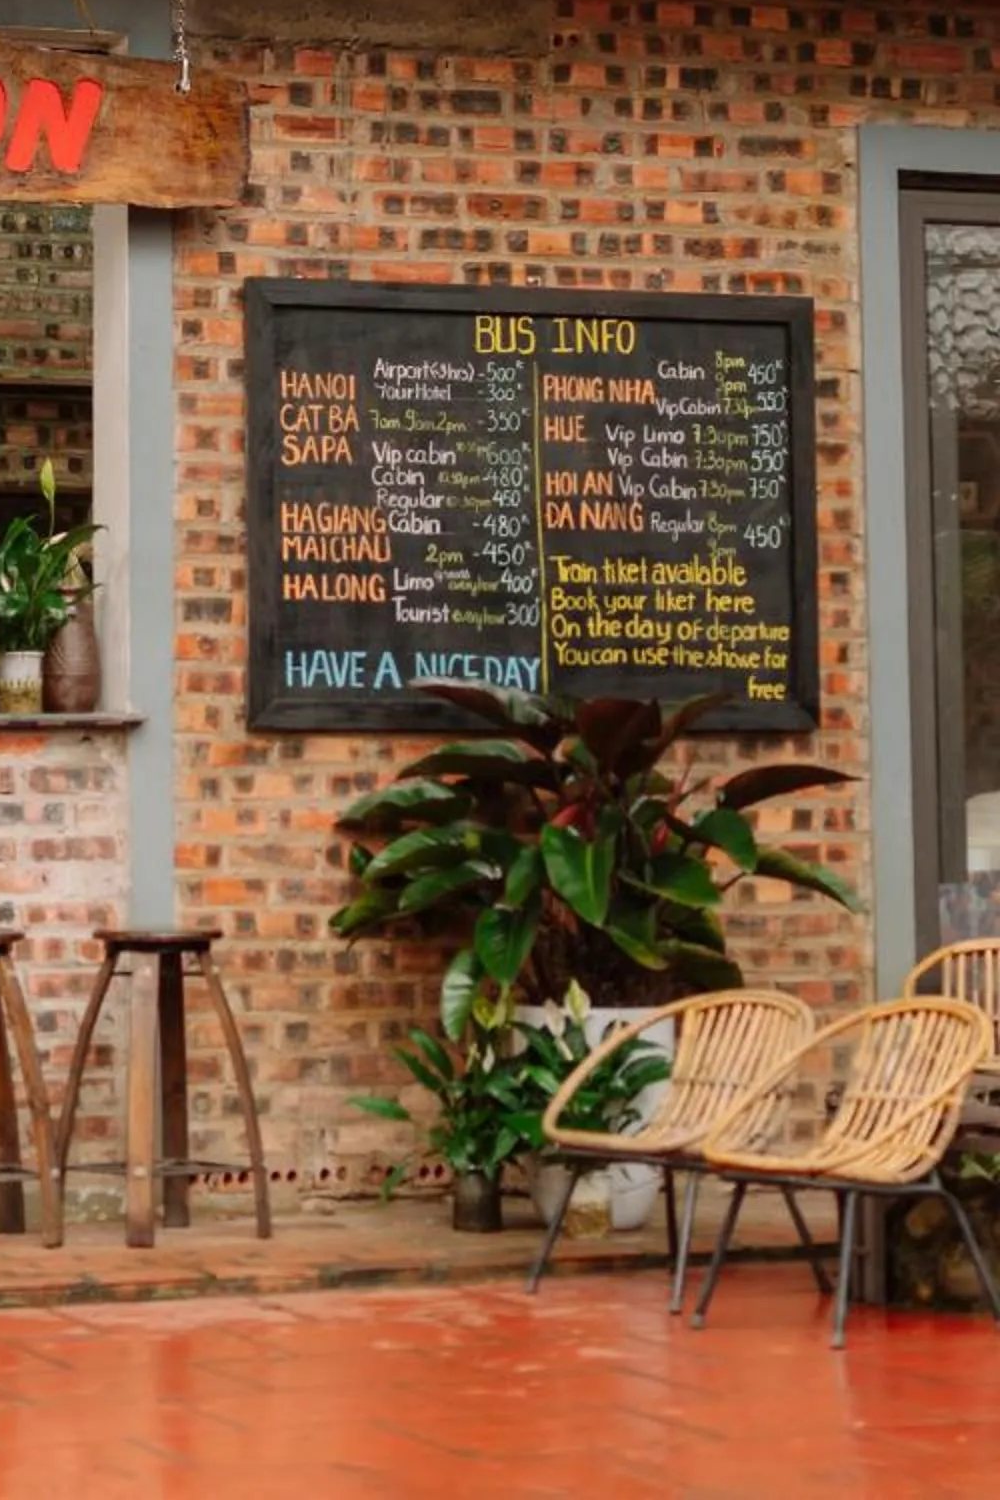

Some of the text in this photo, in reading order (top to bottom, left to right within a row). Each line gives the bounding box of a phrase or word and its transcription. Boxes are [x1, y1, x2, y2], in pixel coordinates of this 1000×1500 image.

[474, 315, 636, 355] BUS INFO
[280, 369, 355, 399] HANOI
[657, 360, 705, 380] Cabin
[543, 374, 657, 406] PHONG NHA
[280, 403, 324, 432] CAT
[328, 404, 360, 433] BA
[544, 415, 587, 443] HUE
[605, 423, 636, 447] Vip
[643, 424, 685, 444] Limo
[281, 435, 353, 466] SAPA
[371, 441, 402, 470] Vip
[406, 440, 457, 466] cabin
[607, 448, 634, 474] Vip
[640, 449, 688, 470] Cabin
[371, 465, 424, 486] Cabin
[546, 471, 578, 497] HOI
[582, 470, 613, 496] AN
[617, 475, 645, 502] Vip
[650, 474, 697, 500] Cabin
[376, 487, 445, 516] Regular
[388, 509, 441, 535] Cabin
[581, 501, 645, 533] NANG
[650, 508, 704, 542] Regular
[424, 543, 464, 568] 2pm
[549, 555, 597, 583] Train
[652, 554, 747, 587] available
[393, 568, 434, 592] Limo
[392, 596, 451, 623] Tourist
[551, 587, 600, 614] Book
[604, 593, 647, 614] your
[705, 588, 756, 614] here
[551, 614, 581, 639] On
[587, 612, 622, 638] the
[625, 614, 672, 644] day
[553, 641, 590, 666] You
[591, 648, 627, 665] can
[633, 647, 670, 666] use
[286, 650, 541, 693] HAVE A NICE DAY
